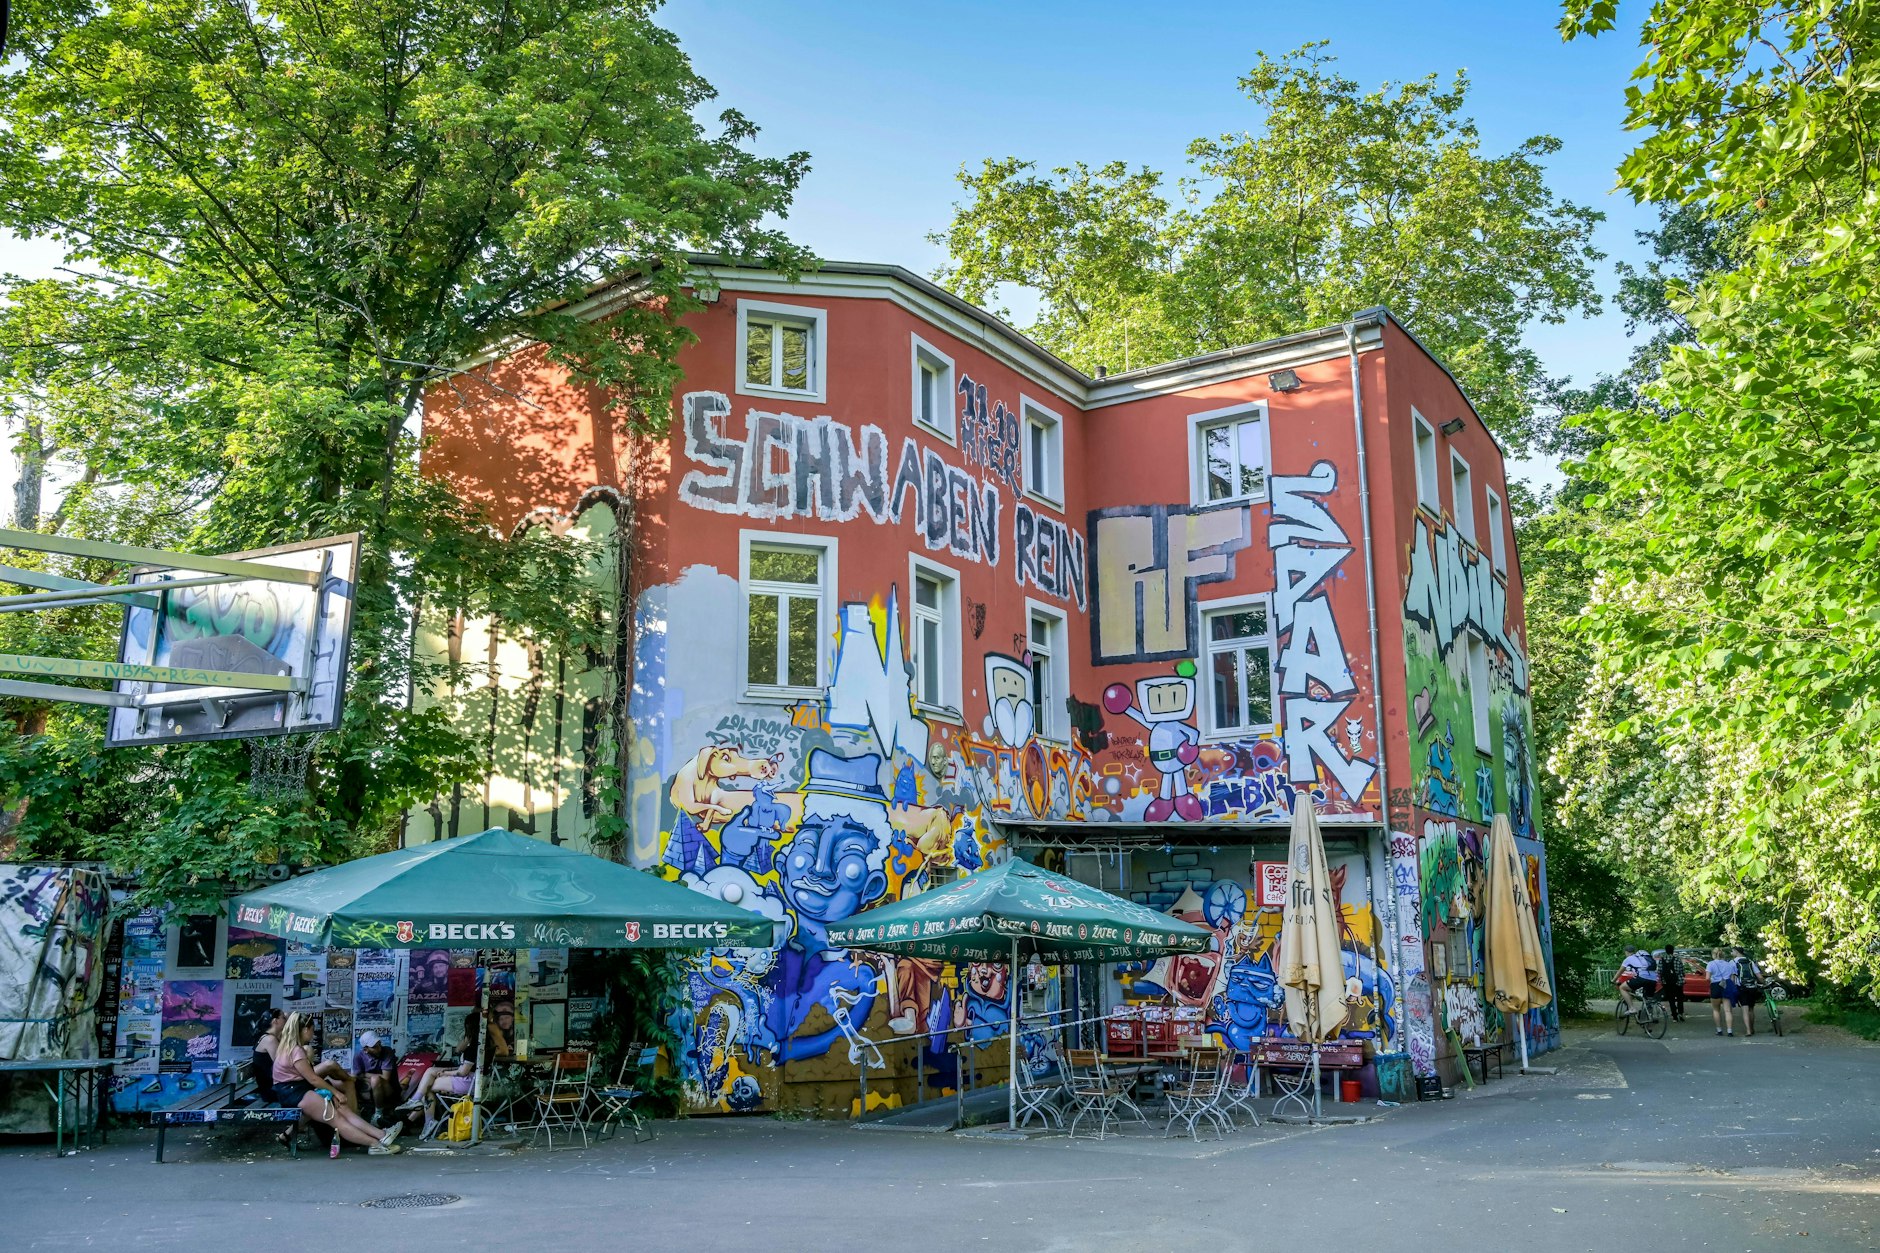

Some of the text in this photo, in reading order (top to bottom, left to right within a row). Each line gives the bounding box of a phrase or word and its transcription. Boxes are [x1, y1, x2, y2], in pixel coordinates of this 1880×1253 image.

[1014, 502, 1087, 613] REIN
[429, 921, 515, 940] BECK'S
[653, 921, 727, 939] BECK'S
[855, 927, 876, 940] ŽATEC
[887, 923, 909, 937] ŽATEC
[923, 920, 945, 935] ŽATEC
[1045, 921, 1074, 937] ŽATEC
[1091, 925, 1118, 940] ŽATEC
[1136, 930, 1163, 945] ŽATEC
